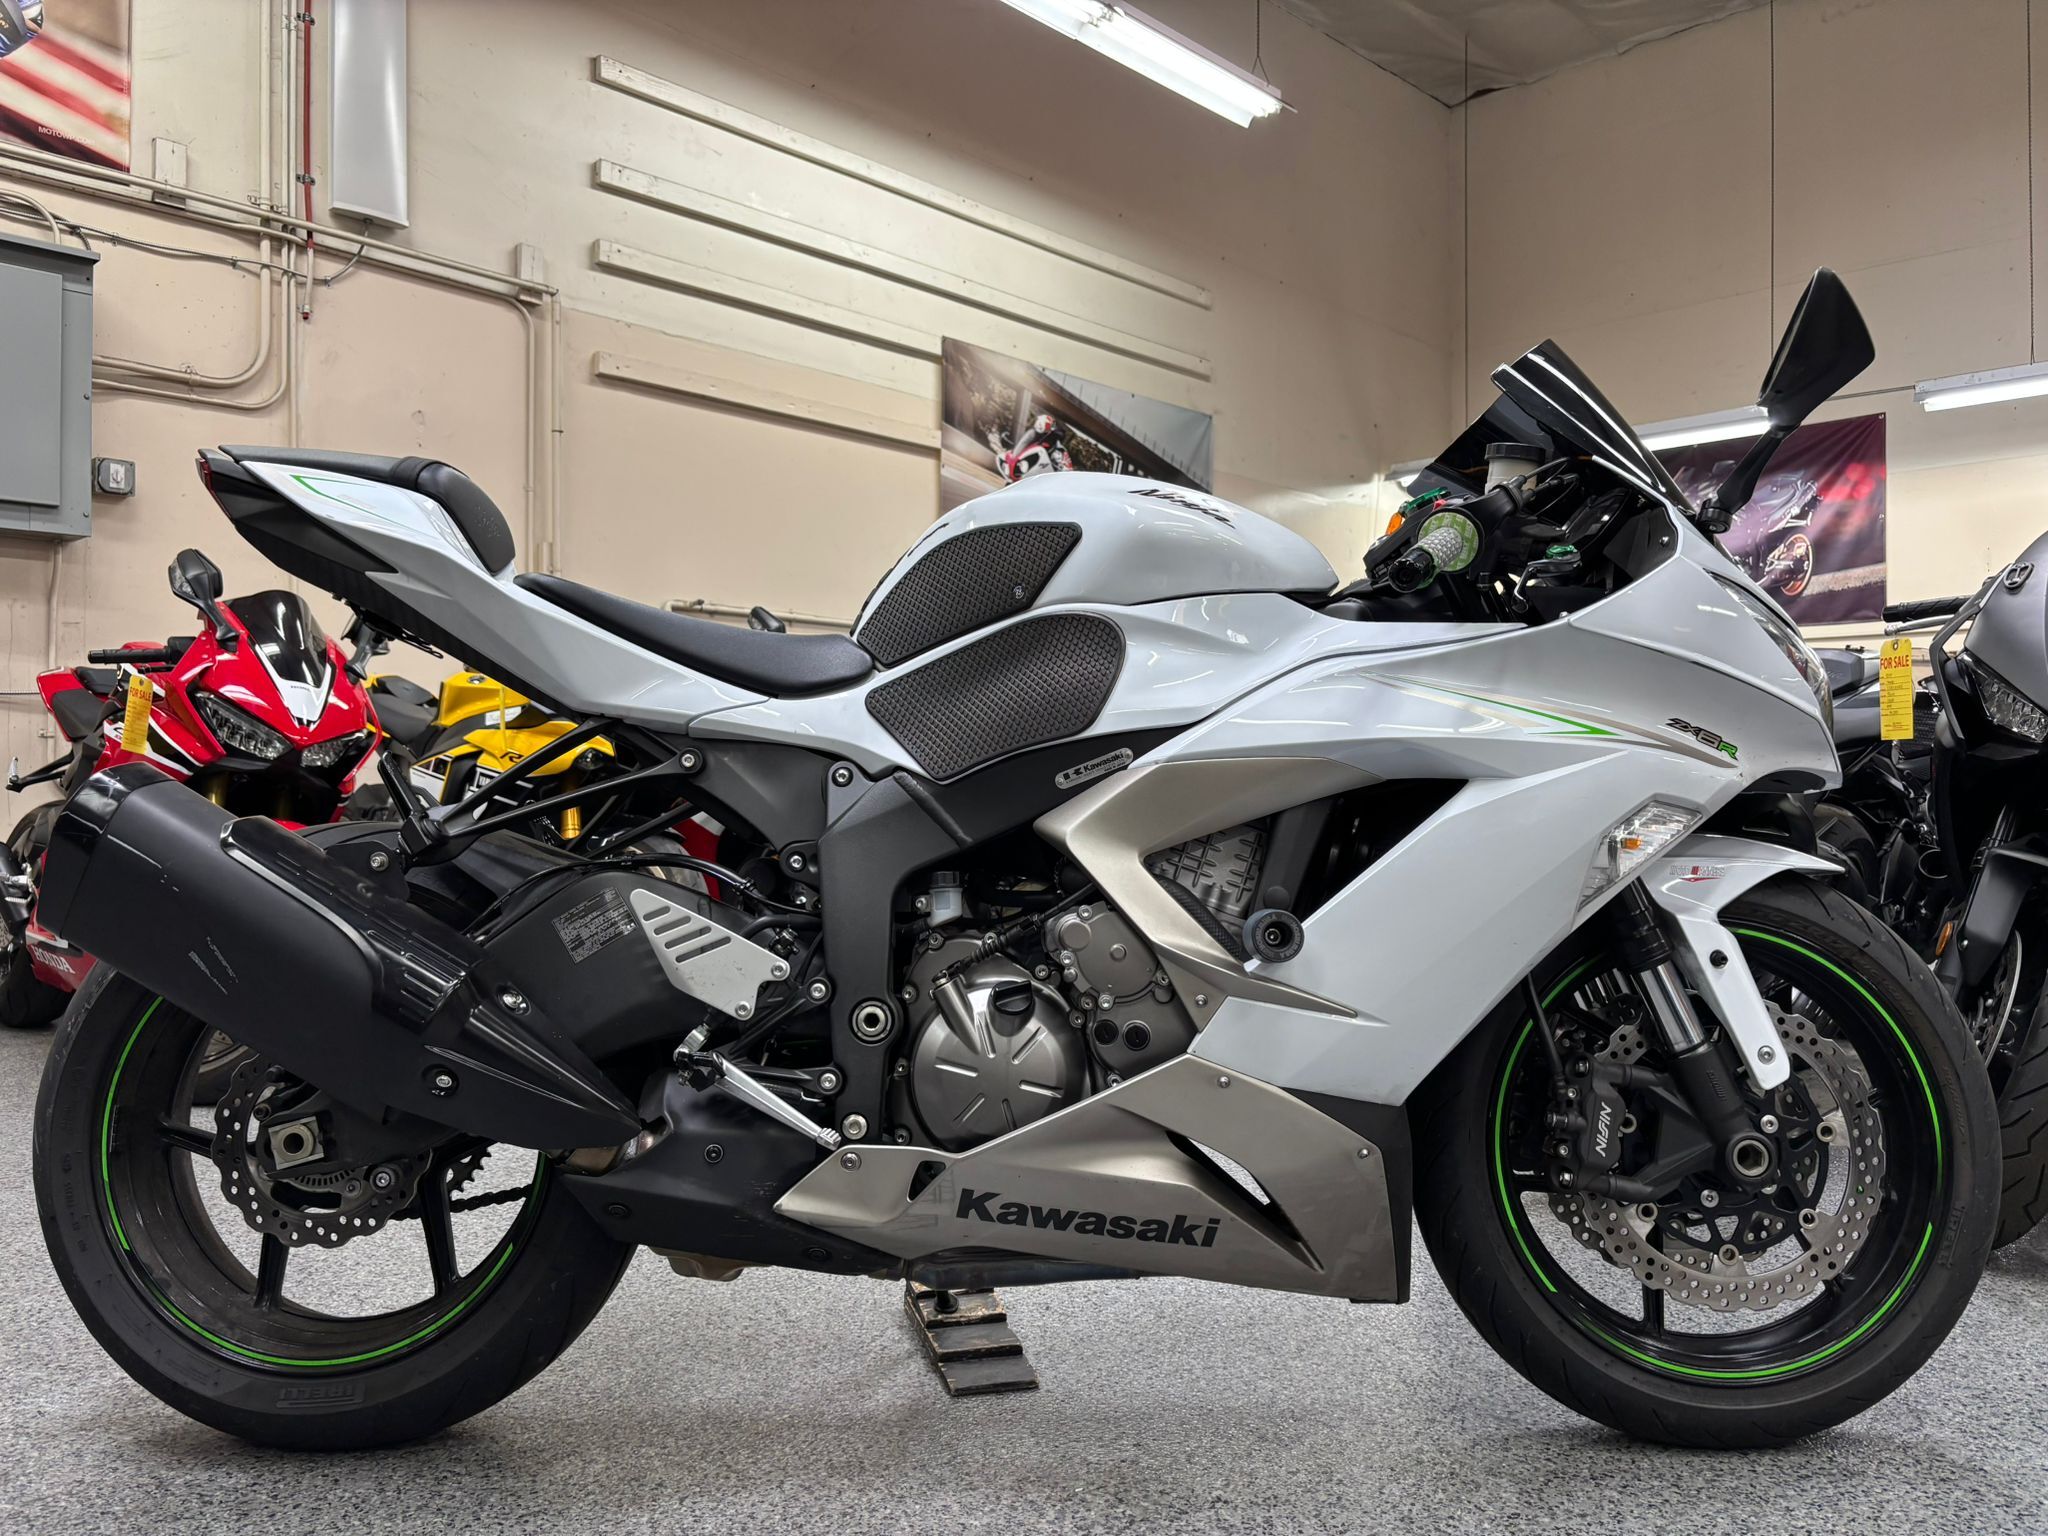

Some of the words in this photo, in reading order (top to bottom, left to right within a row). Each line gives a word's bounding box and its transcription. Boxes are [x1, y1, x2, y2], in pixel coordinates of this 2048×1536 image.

[1880, 657, 1893, 670] FOR
[1894, 655, 1910, 668] SALE
[129, 686, 139, 698] FOR
[139, 689, 152, 701] SALE
[1083, 752, 1124, 773] Kawasaki
[30, 944, 76, 975] HONDA
[955, 1188, 1221, 1248] Kawasaki
